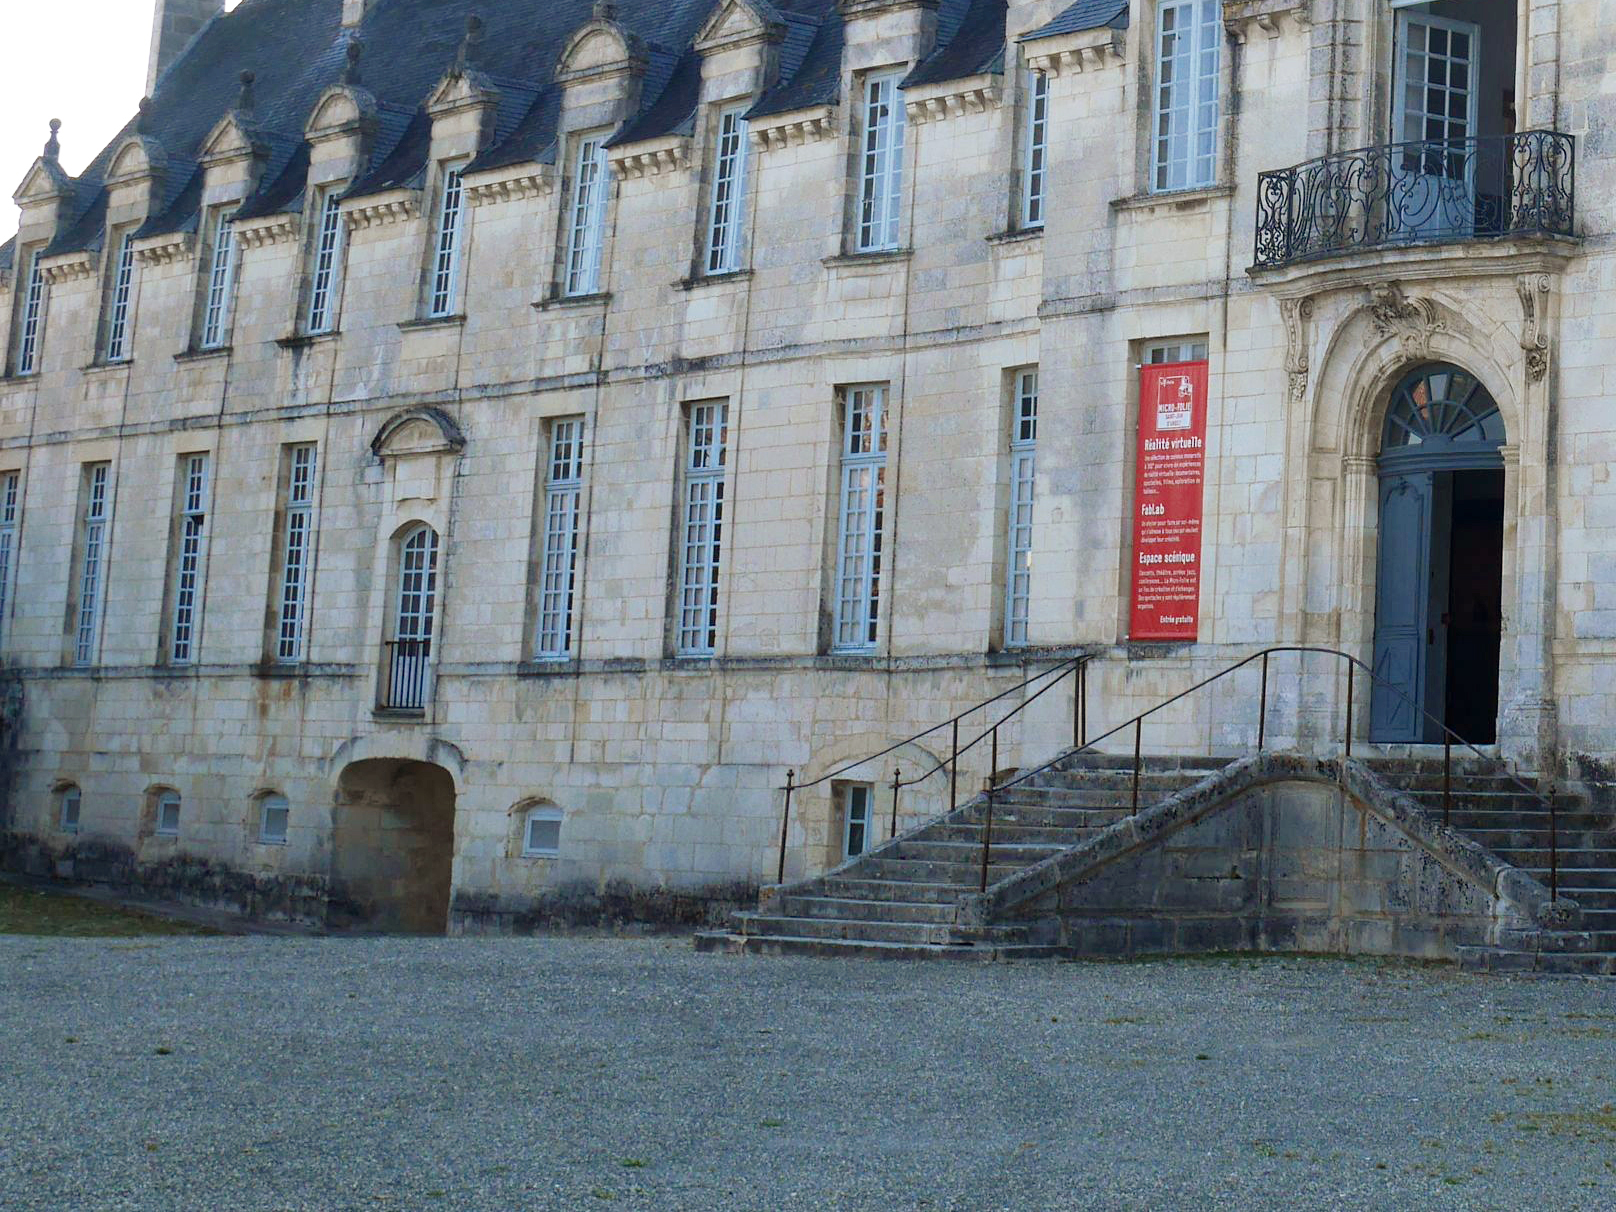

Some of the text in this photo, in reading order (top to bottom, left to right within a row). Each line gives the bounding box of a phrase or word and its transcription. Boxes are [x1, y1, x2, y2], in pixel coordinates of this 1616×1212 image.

[1145, 436, 1201, 451] Réalité virtuelle
[1142, 503, 1165, 516] FabLab
[1140, 550, 1195, 565] Espace scénique
